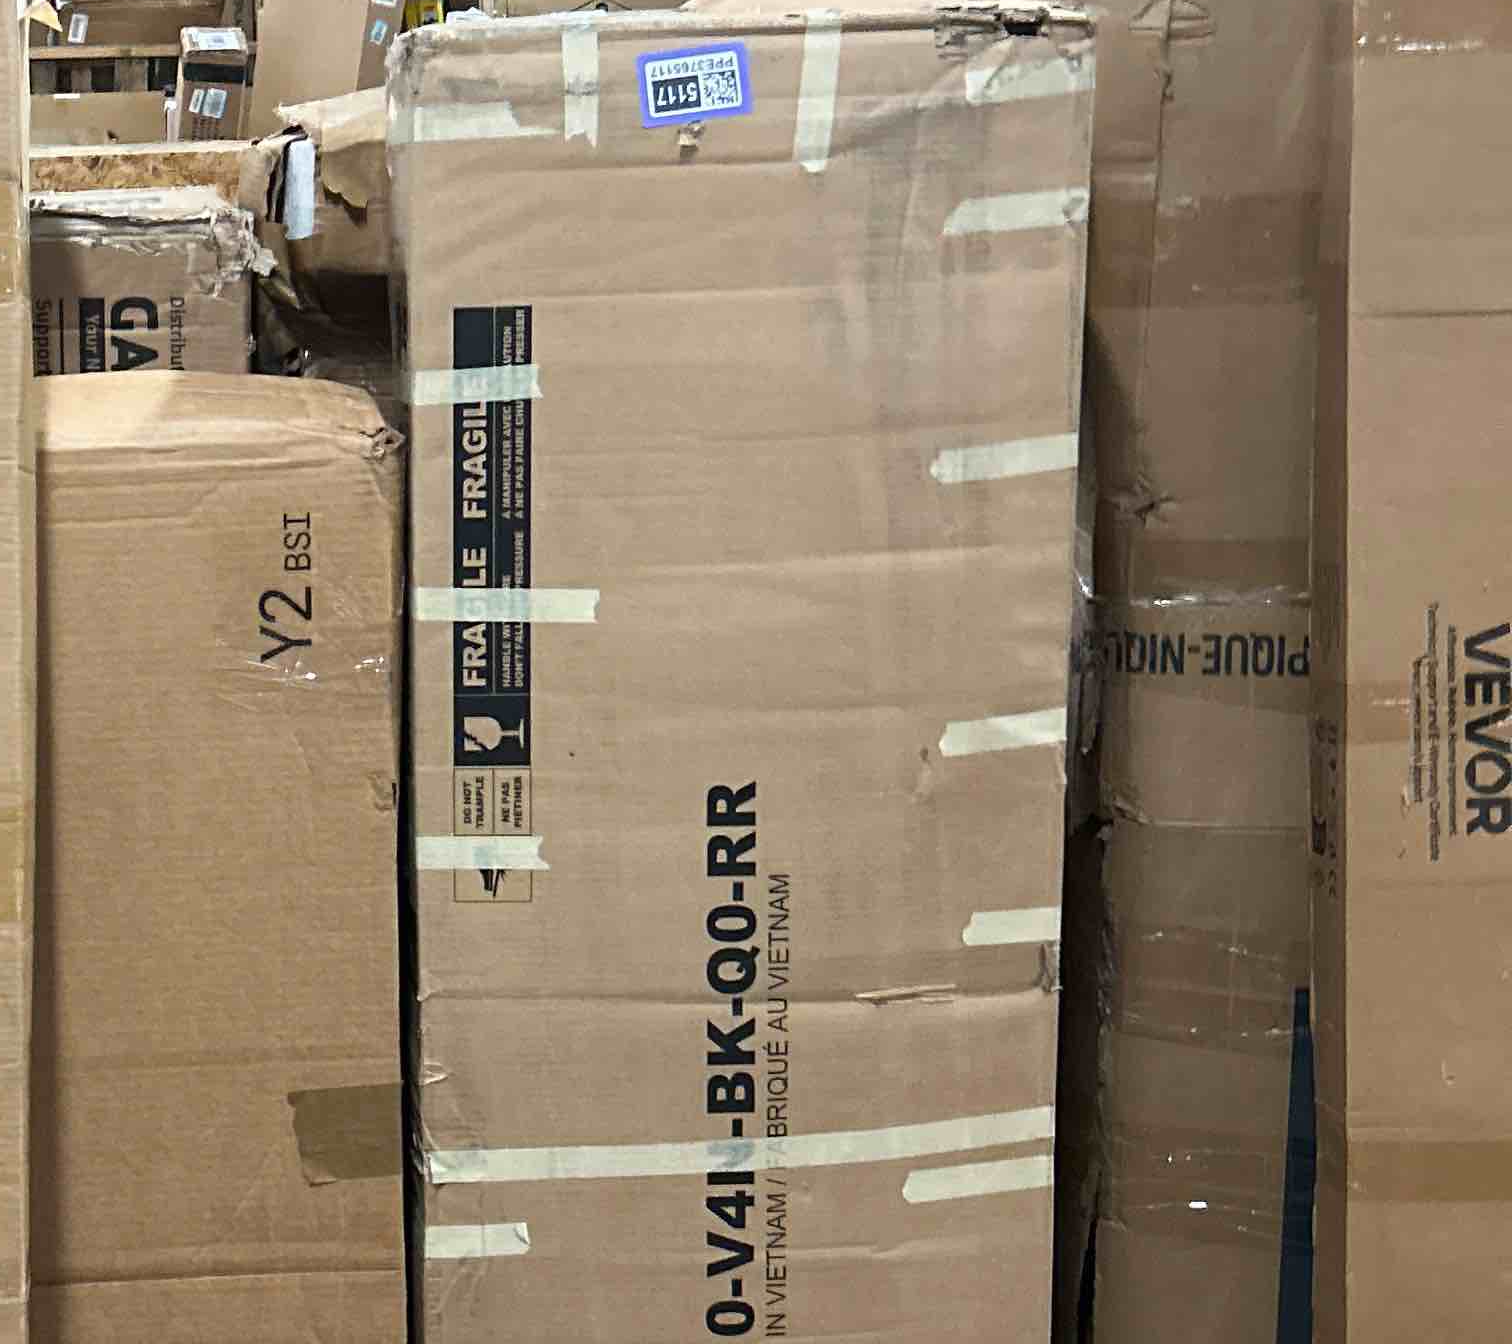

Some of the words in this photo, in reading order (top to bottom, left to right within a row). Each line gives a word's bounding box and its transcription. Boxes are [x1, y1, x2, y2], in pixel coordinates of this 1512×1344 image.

[656, 82, 697, 106] 5117
[284, 512, 311, 571] BSI
[259, 587, 312, 663] Y2
[1074, 632, 1310, 677] PIQUE-NIQU
[1464, 622, 1512, 836] VEVOR
[463, 782, 472, 805] NOT
[768, 874, 790, 992] VIETNAM
[767, 996, 789, 1033] AU
[766, 1192, 787, 1308] VIETNAM
[765, 1313, 786, 1337] IN
